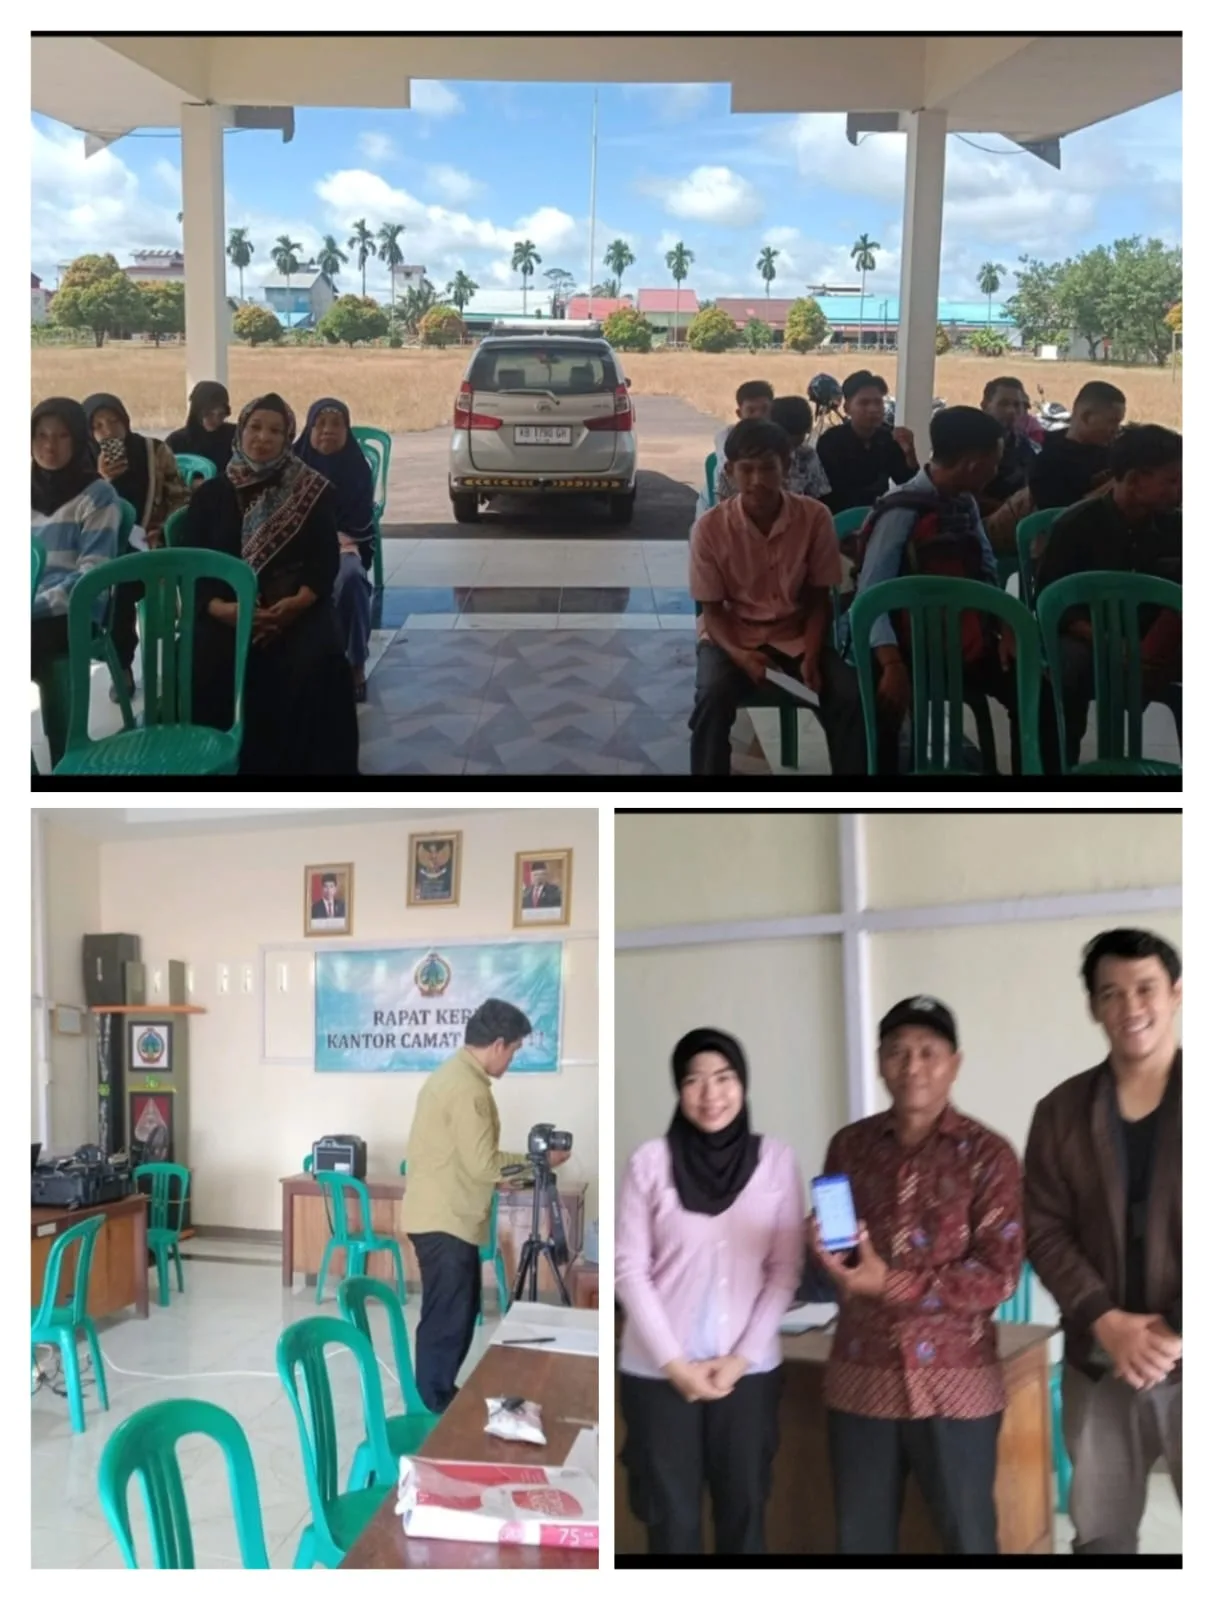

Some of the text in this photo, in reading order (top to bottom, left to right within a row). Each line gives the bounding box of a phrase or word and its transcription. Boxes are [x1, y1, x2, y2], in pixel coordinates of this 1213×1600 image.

[373, 1009, 477, 1026] RAPAT KER
[327, 1032, 461, 1049] KANTOR CAMAT
[559, 1527, 580, 1546] 75
